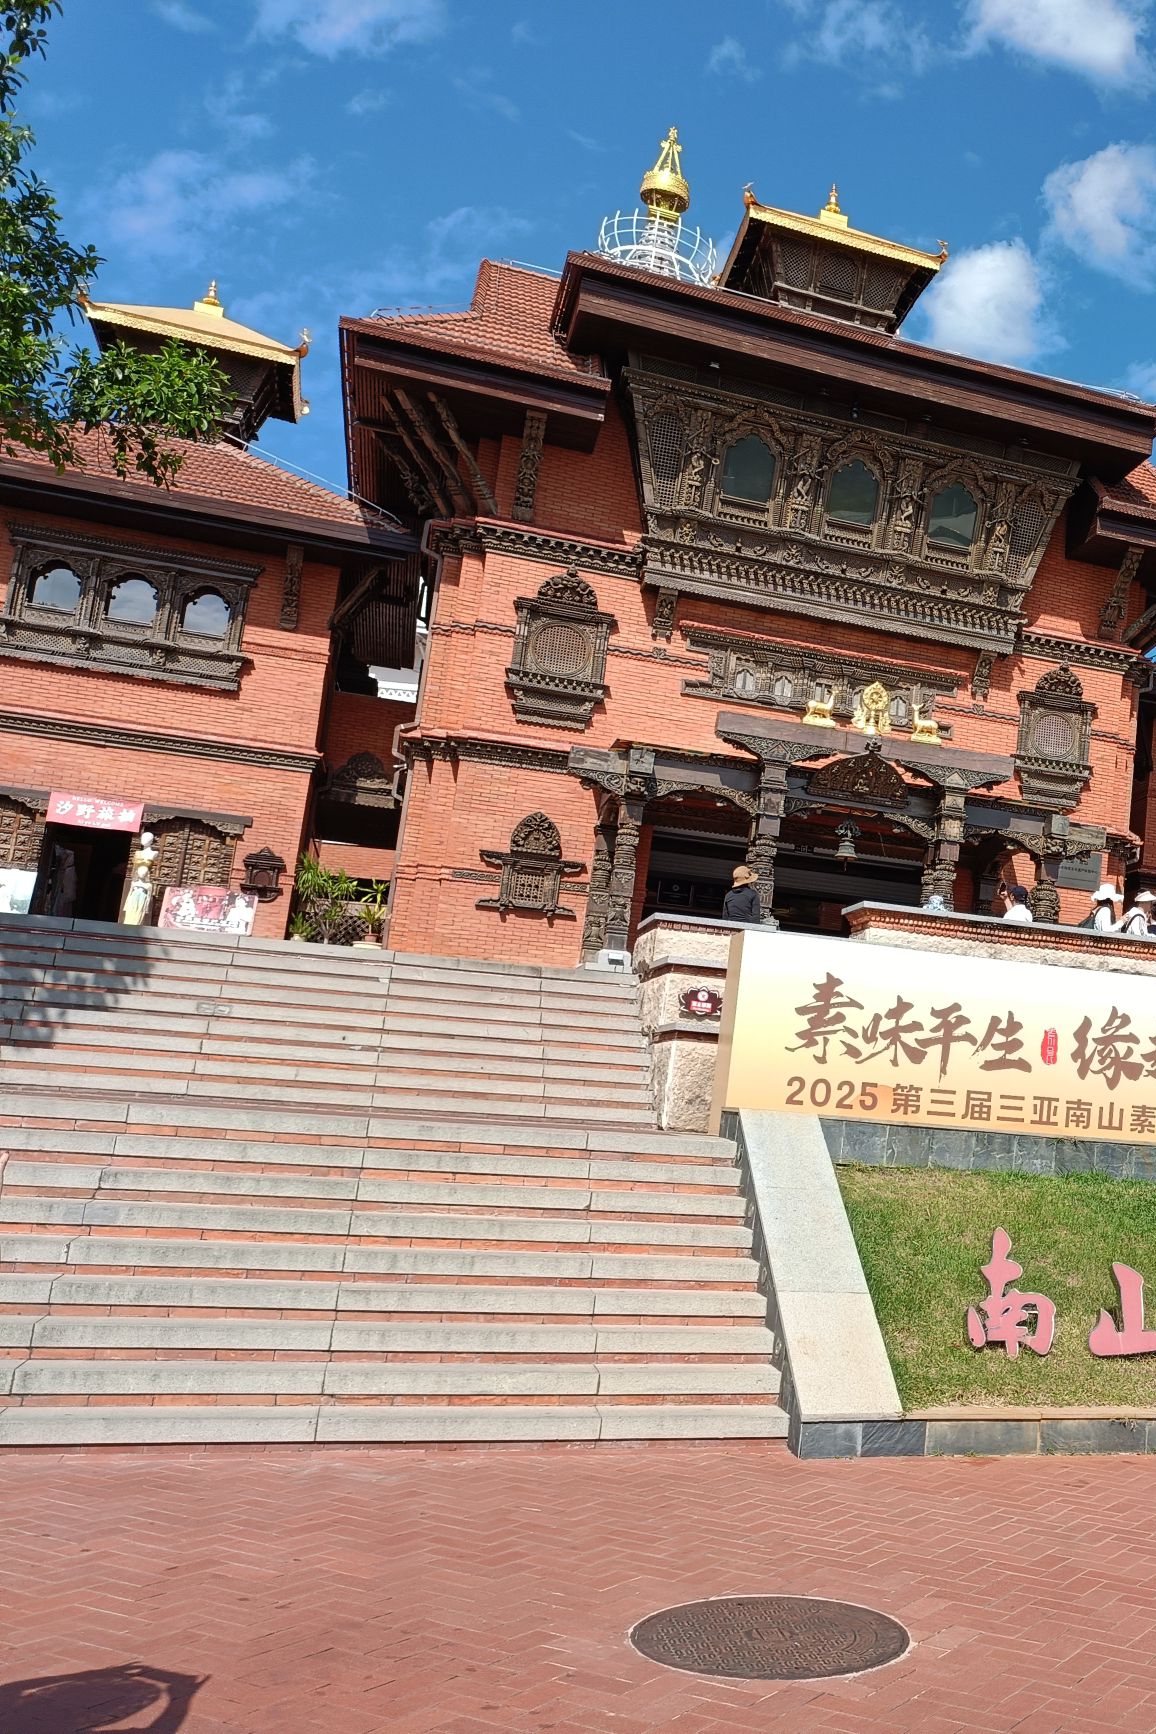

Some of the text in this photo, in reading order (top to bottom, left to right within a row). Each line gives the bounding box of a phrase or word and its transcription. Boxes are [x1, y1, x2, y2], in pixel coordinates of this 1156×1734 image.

[785, 972, 1032, 1084] 素味平生
[785, 1076, 878, 1111] 2025
